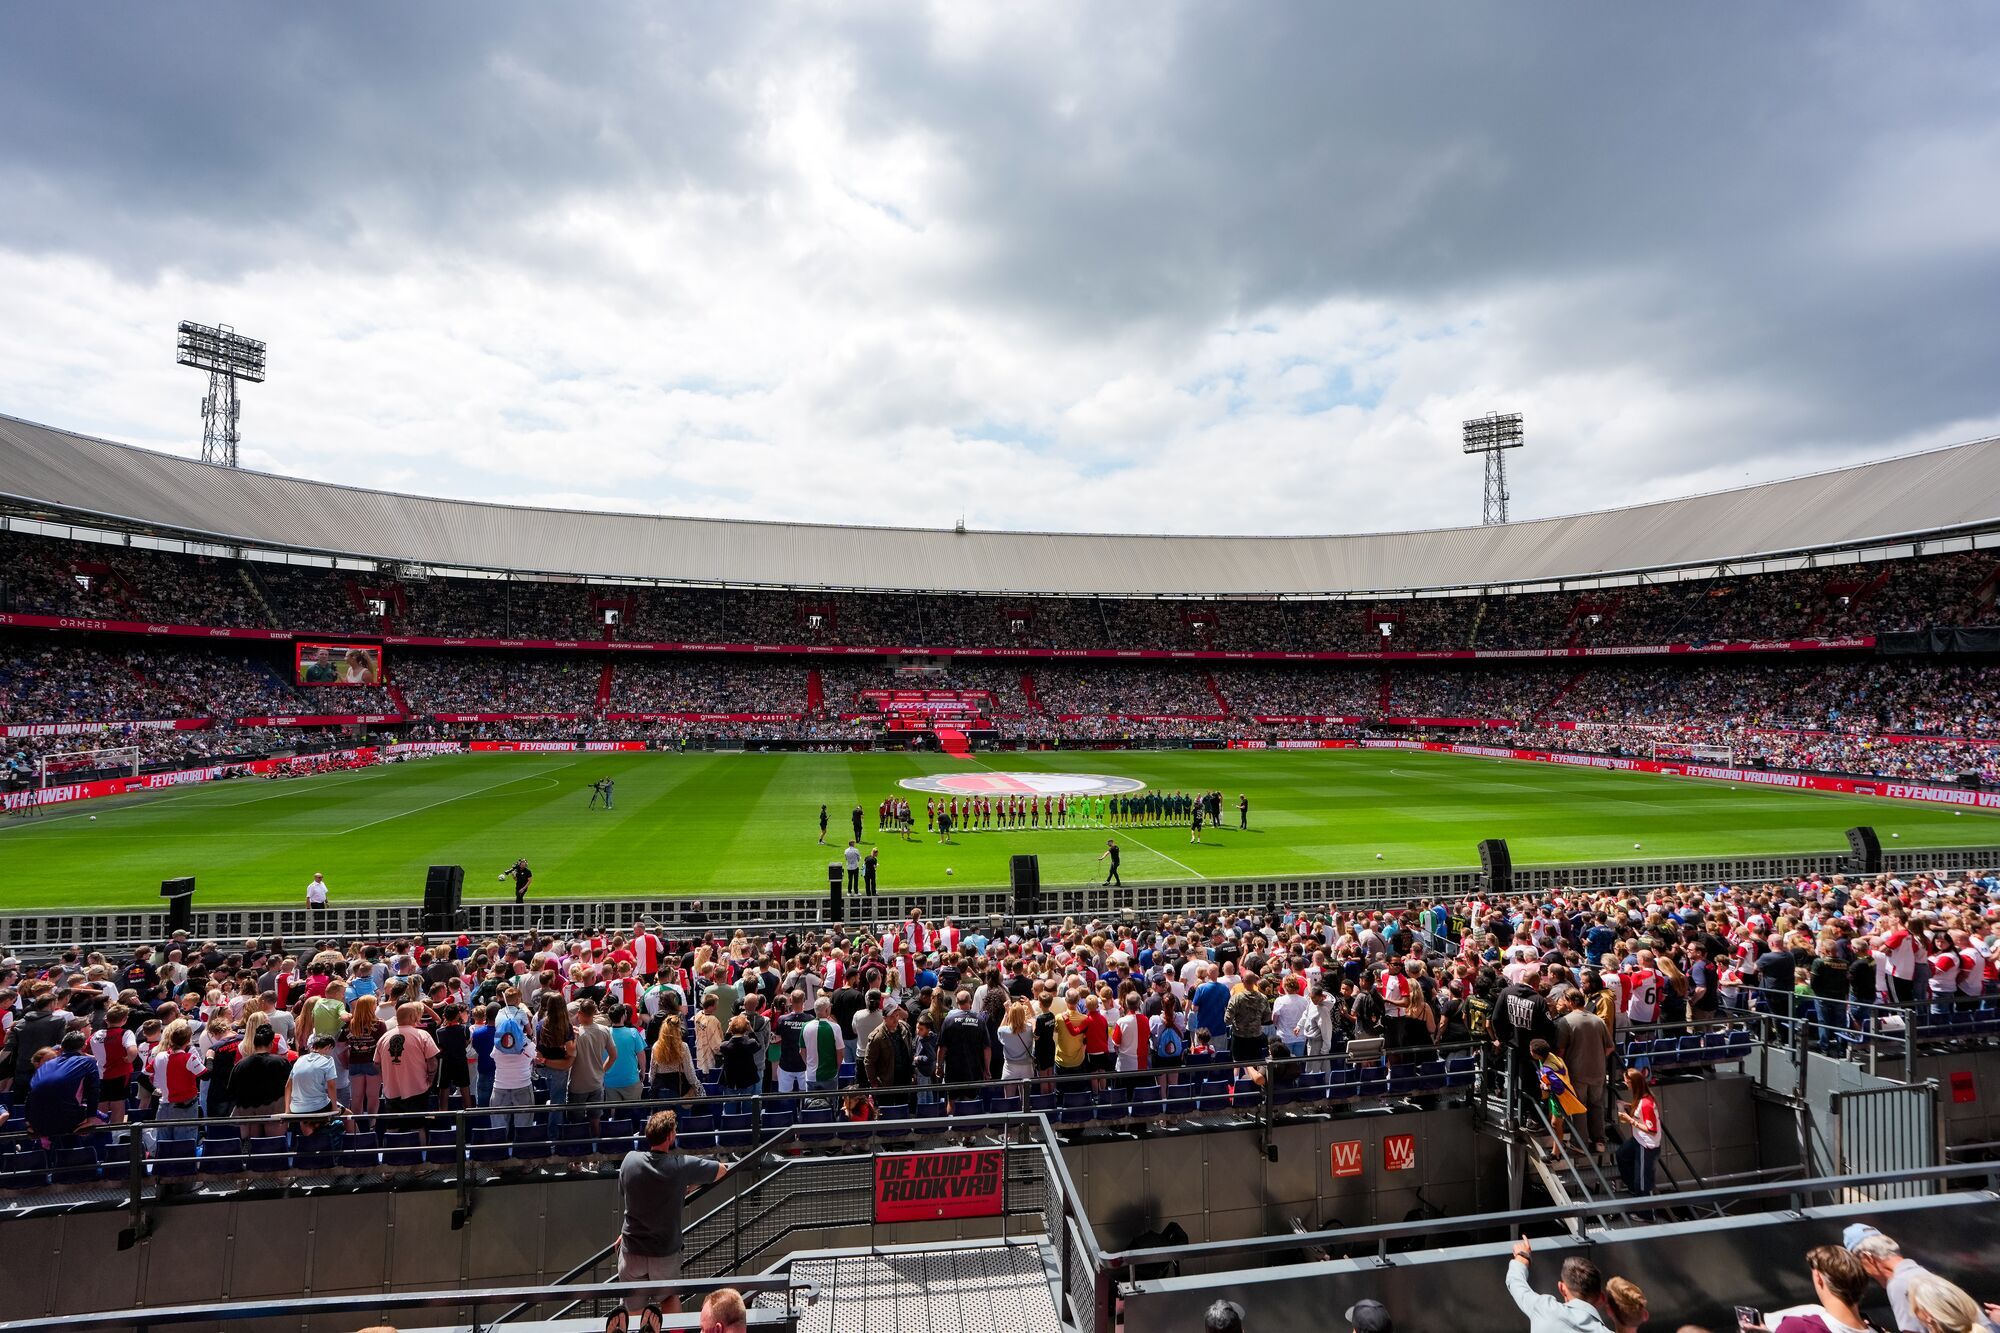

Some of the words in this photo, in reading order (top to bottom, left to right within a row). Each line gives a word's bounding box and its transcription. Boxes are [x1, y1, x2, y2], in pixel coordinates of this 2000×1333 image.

[60, 619, 101, 629] ORMER
[1612, 646, 1670, 654] BEKERWINNAAR
[7, 726, 54, 737] WILLEM
[56, 724, 80, 735] VAN
[520, 742, 570, 750] FEYENOORD
[1452, 745, 1481, 754] FEYENOORD
[1482, 748, 1510, 757] VROUWEN
[1550, 754, 1590, 766] FEYENOORD
[150, 769, 203, 788] FEYENOORD
[1686, 766, 1742, 780] FEYENOORD
[1744, 770, 1799, 786] VROUWEN
[1800, 776, 1806, 787] 1
[1886, 784, 1976, 805] FEYENOORD
[1644, 987, 1656, 1005] 6
[1335, 1144, 1358, 1166] W
[1389, 1138, 1410, 1160] W
[880, 1158, 913, 1180] DE
[914, 1154, 972, 1178] KUIP
[974, 1152, 1000, 1174] IS
